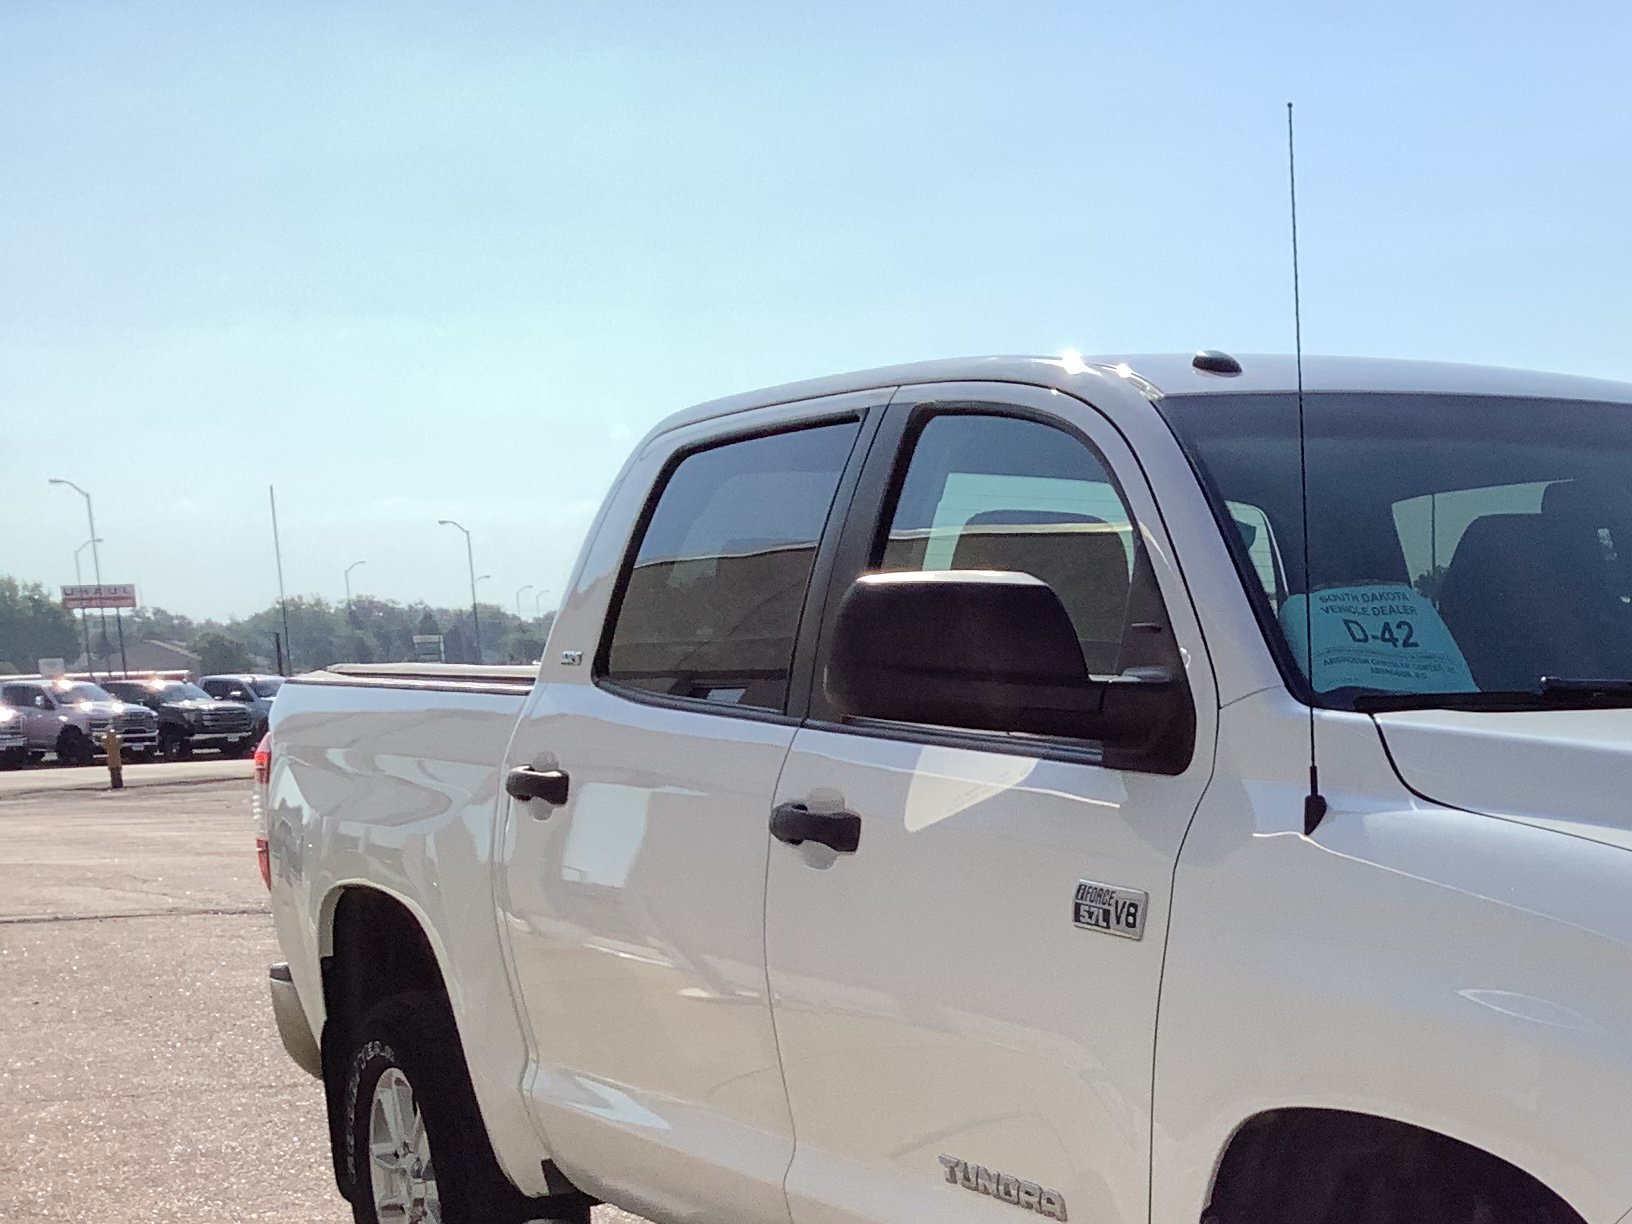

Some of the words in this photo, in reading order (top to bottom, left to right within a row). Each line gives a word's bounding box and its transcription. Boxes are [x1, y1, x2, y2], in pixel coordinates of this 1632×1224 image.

[1319, 594, 1360, 603] SOUTH
[1361, 591, 1410, 602] DAKOTA
[1320, 605, 1370, 616] VEHICLE
[1371, 605, 1418, 616] DEALER
[1343, 619, 1419, 648] D-42
[1115, 900, 1139, 929] V8
[938, 1153, 1068, 1223] TUNDRA
